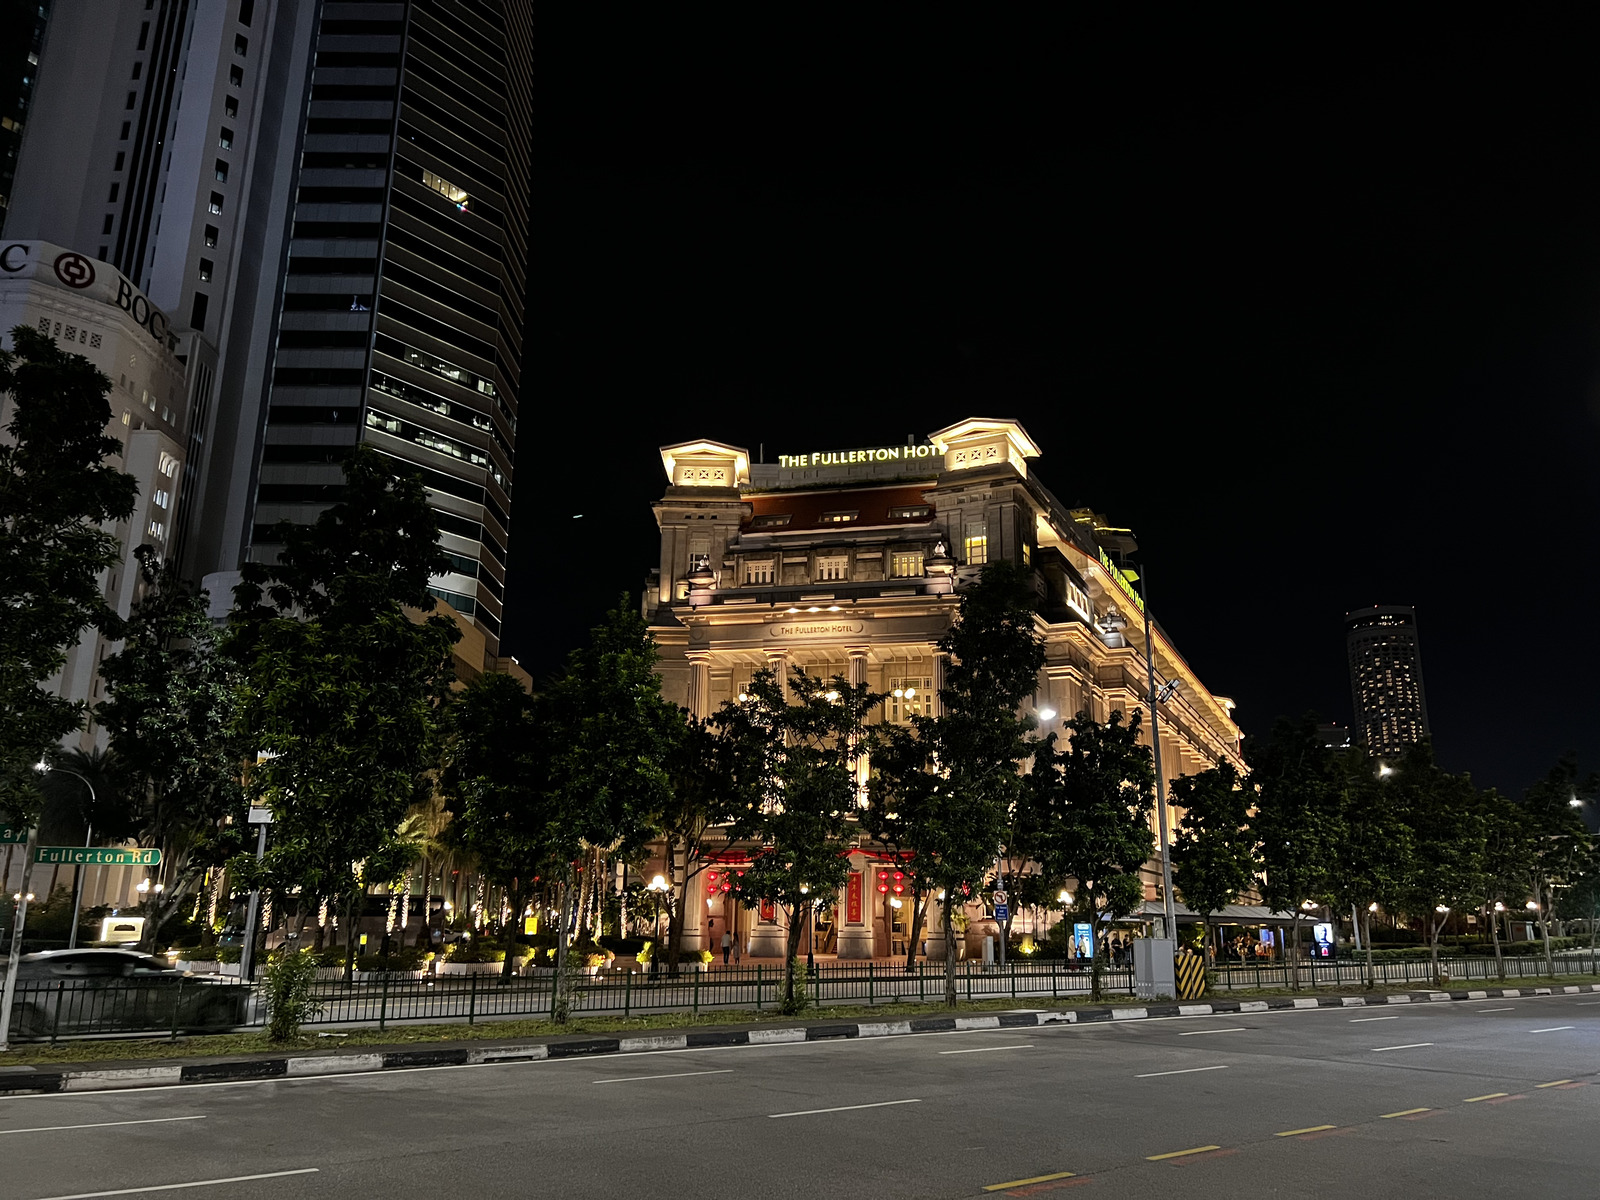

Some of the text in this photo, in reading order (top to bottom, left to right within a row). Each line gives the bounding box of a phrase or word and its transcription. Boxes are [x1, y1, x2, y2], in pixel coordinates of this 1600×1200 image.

[778, 455, 808, 468] THE
[811, 447, 899, 466] FULLERTON
[781, 624, 853, 635] THE FULLERTON HOTEL
[39, 848, 152, 864] Fullerton Rd
